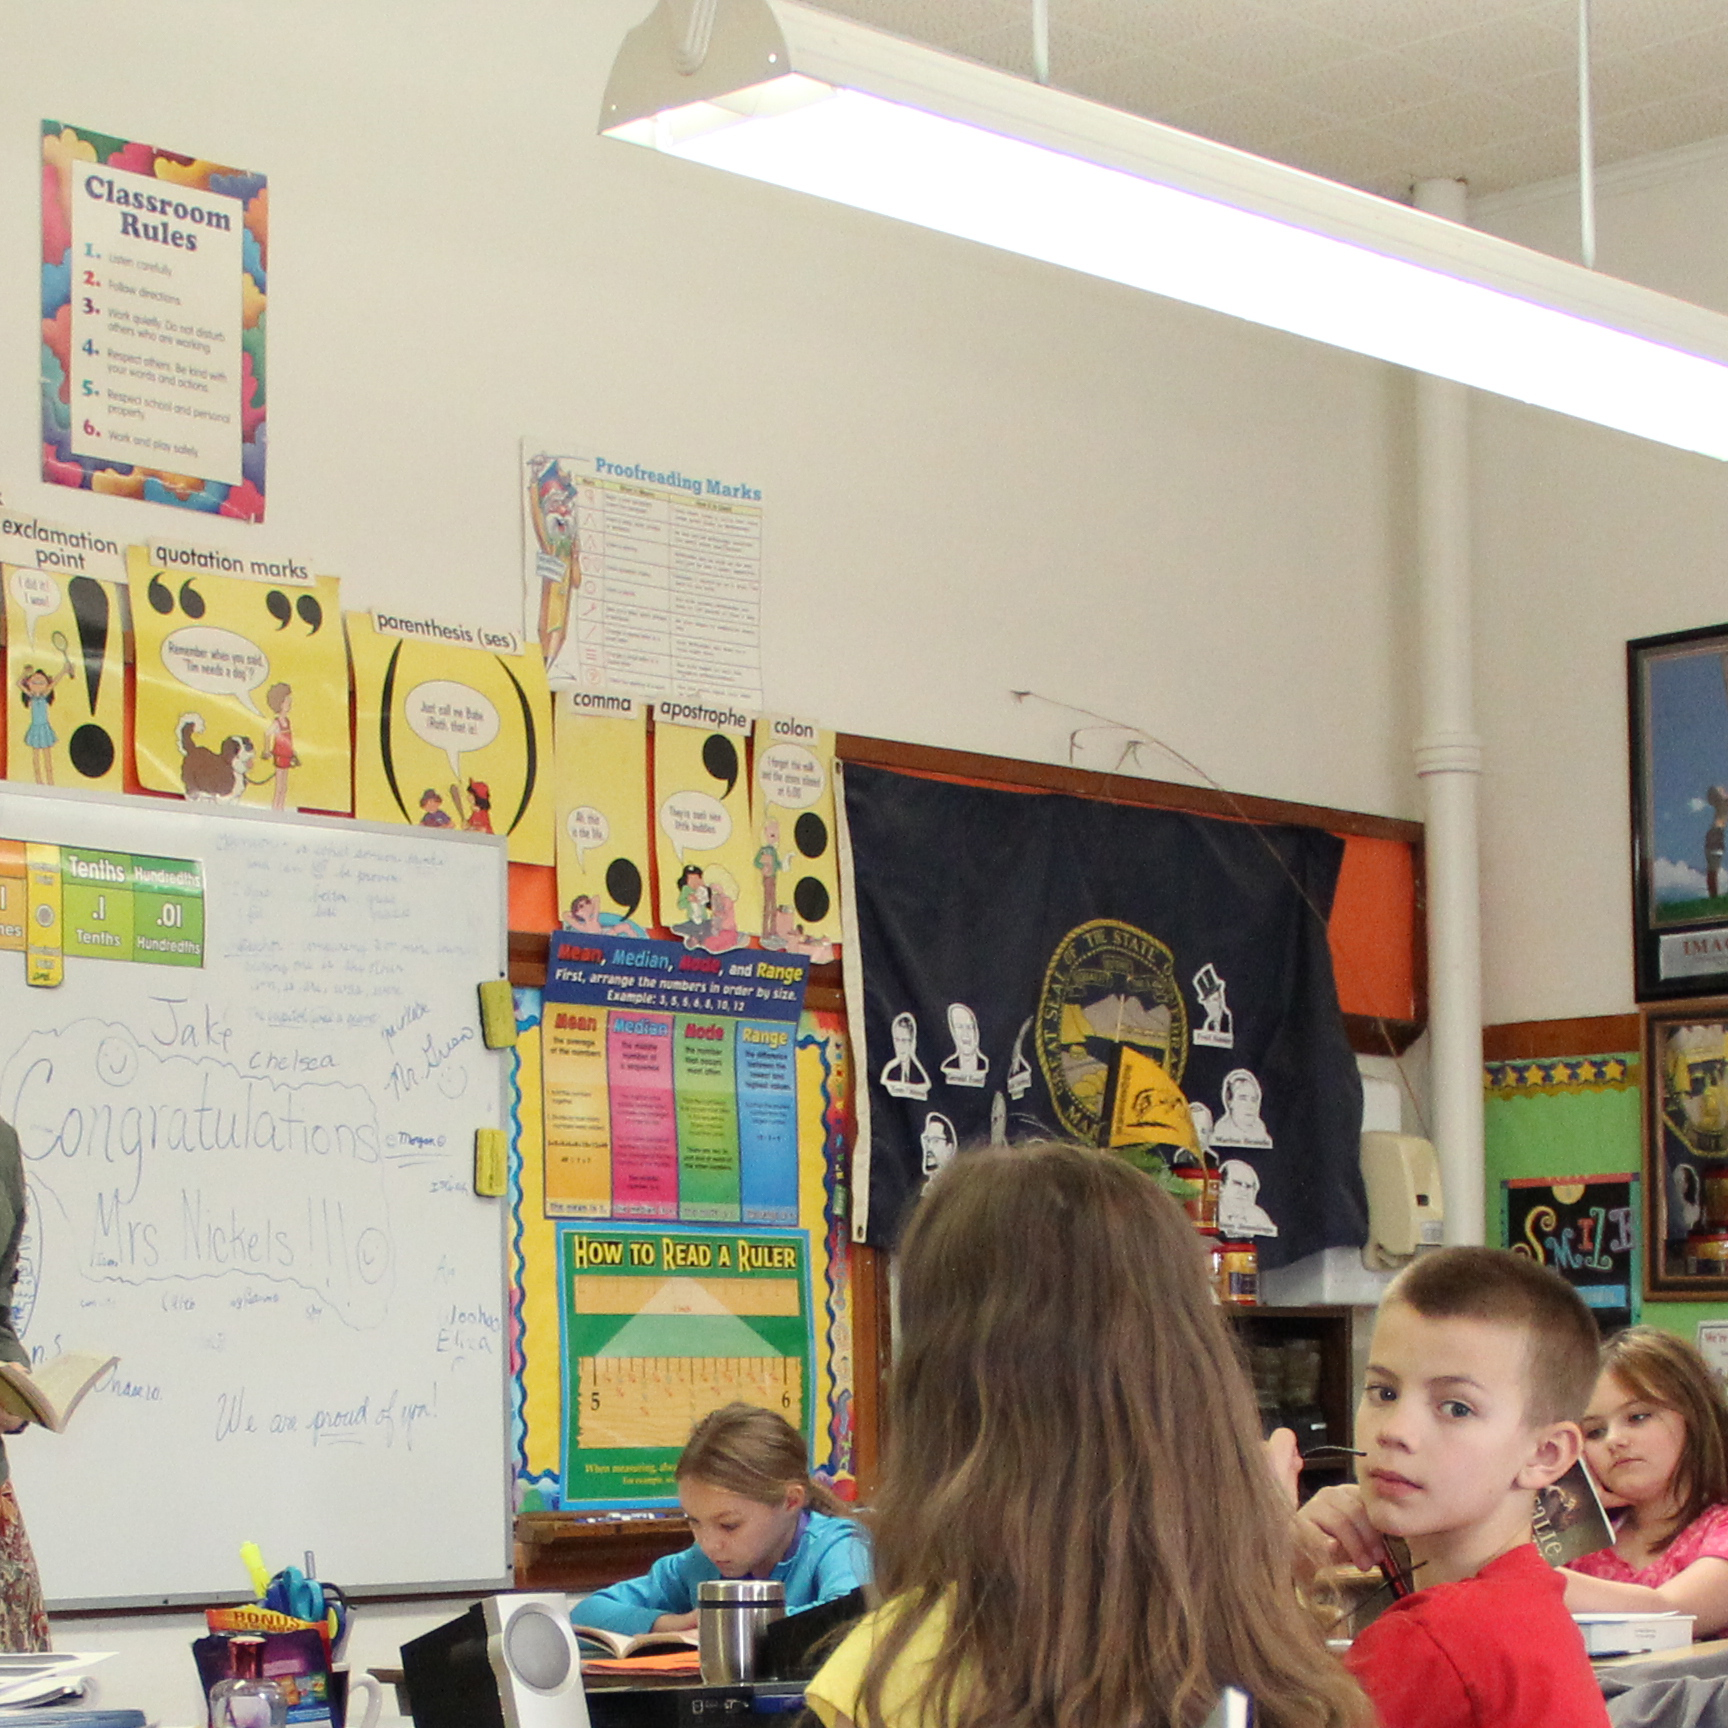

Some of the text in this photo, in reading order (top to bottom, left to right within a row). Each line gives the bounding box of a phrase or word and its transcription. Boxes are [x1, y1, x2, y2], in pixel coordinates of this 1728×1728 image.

[84, 174, 232, 233] Classroom
[120, 210, 199, 252] Rules
[595, 455, 763, 502] Proofreading Marks
[1, 515, 119, 557] exclamation
[35, 545, 86, 573] point
[155, 541, 309, 581] quotation marks
[377, 612, 518, 653] parenthesis (ses)
[573, 690, 633, 713] comma
[659, 698, 748, 730] apostrophe
[773, 718, 814, 739] colon
[68, 855, 126, 883] Tenths
[133, 865, 201, 888] Hundredths
[75, 928, 201, 955] Tenths Hundredths
[611, 948, 674, 973] Median,
[728, 962, 753, 978] and
[755, 961, 805, 986] Range
[555, 967, 798, 1002] First, arrange the numbers in order by size.
[607, 989, 658, 1006] Example:
[148, 995, 234, 1053] Jake
[613, 1016, 789, 1049] Median Mode Range
[13, 1057, 380, 1205] Congratulations
[91, 1187, 159, 1268] Mrs
[718, 1244, 732, 1268] A
[215, 1386, 258, 1441] We
[270, 1413, 299, 1434] are
[307, 1399, 368, 1445] proud
[376, 1388, 400, 1439] of
[590, 1391, 601, 1412] 5
[781, 1390, 791, 1409] 6
[232, 1610, 301, 1630] BONUS
